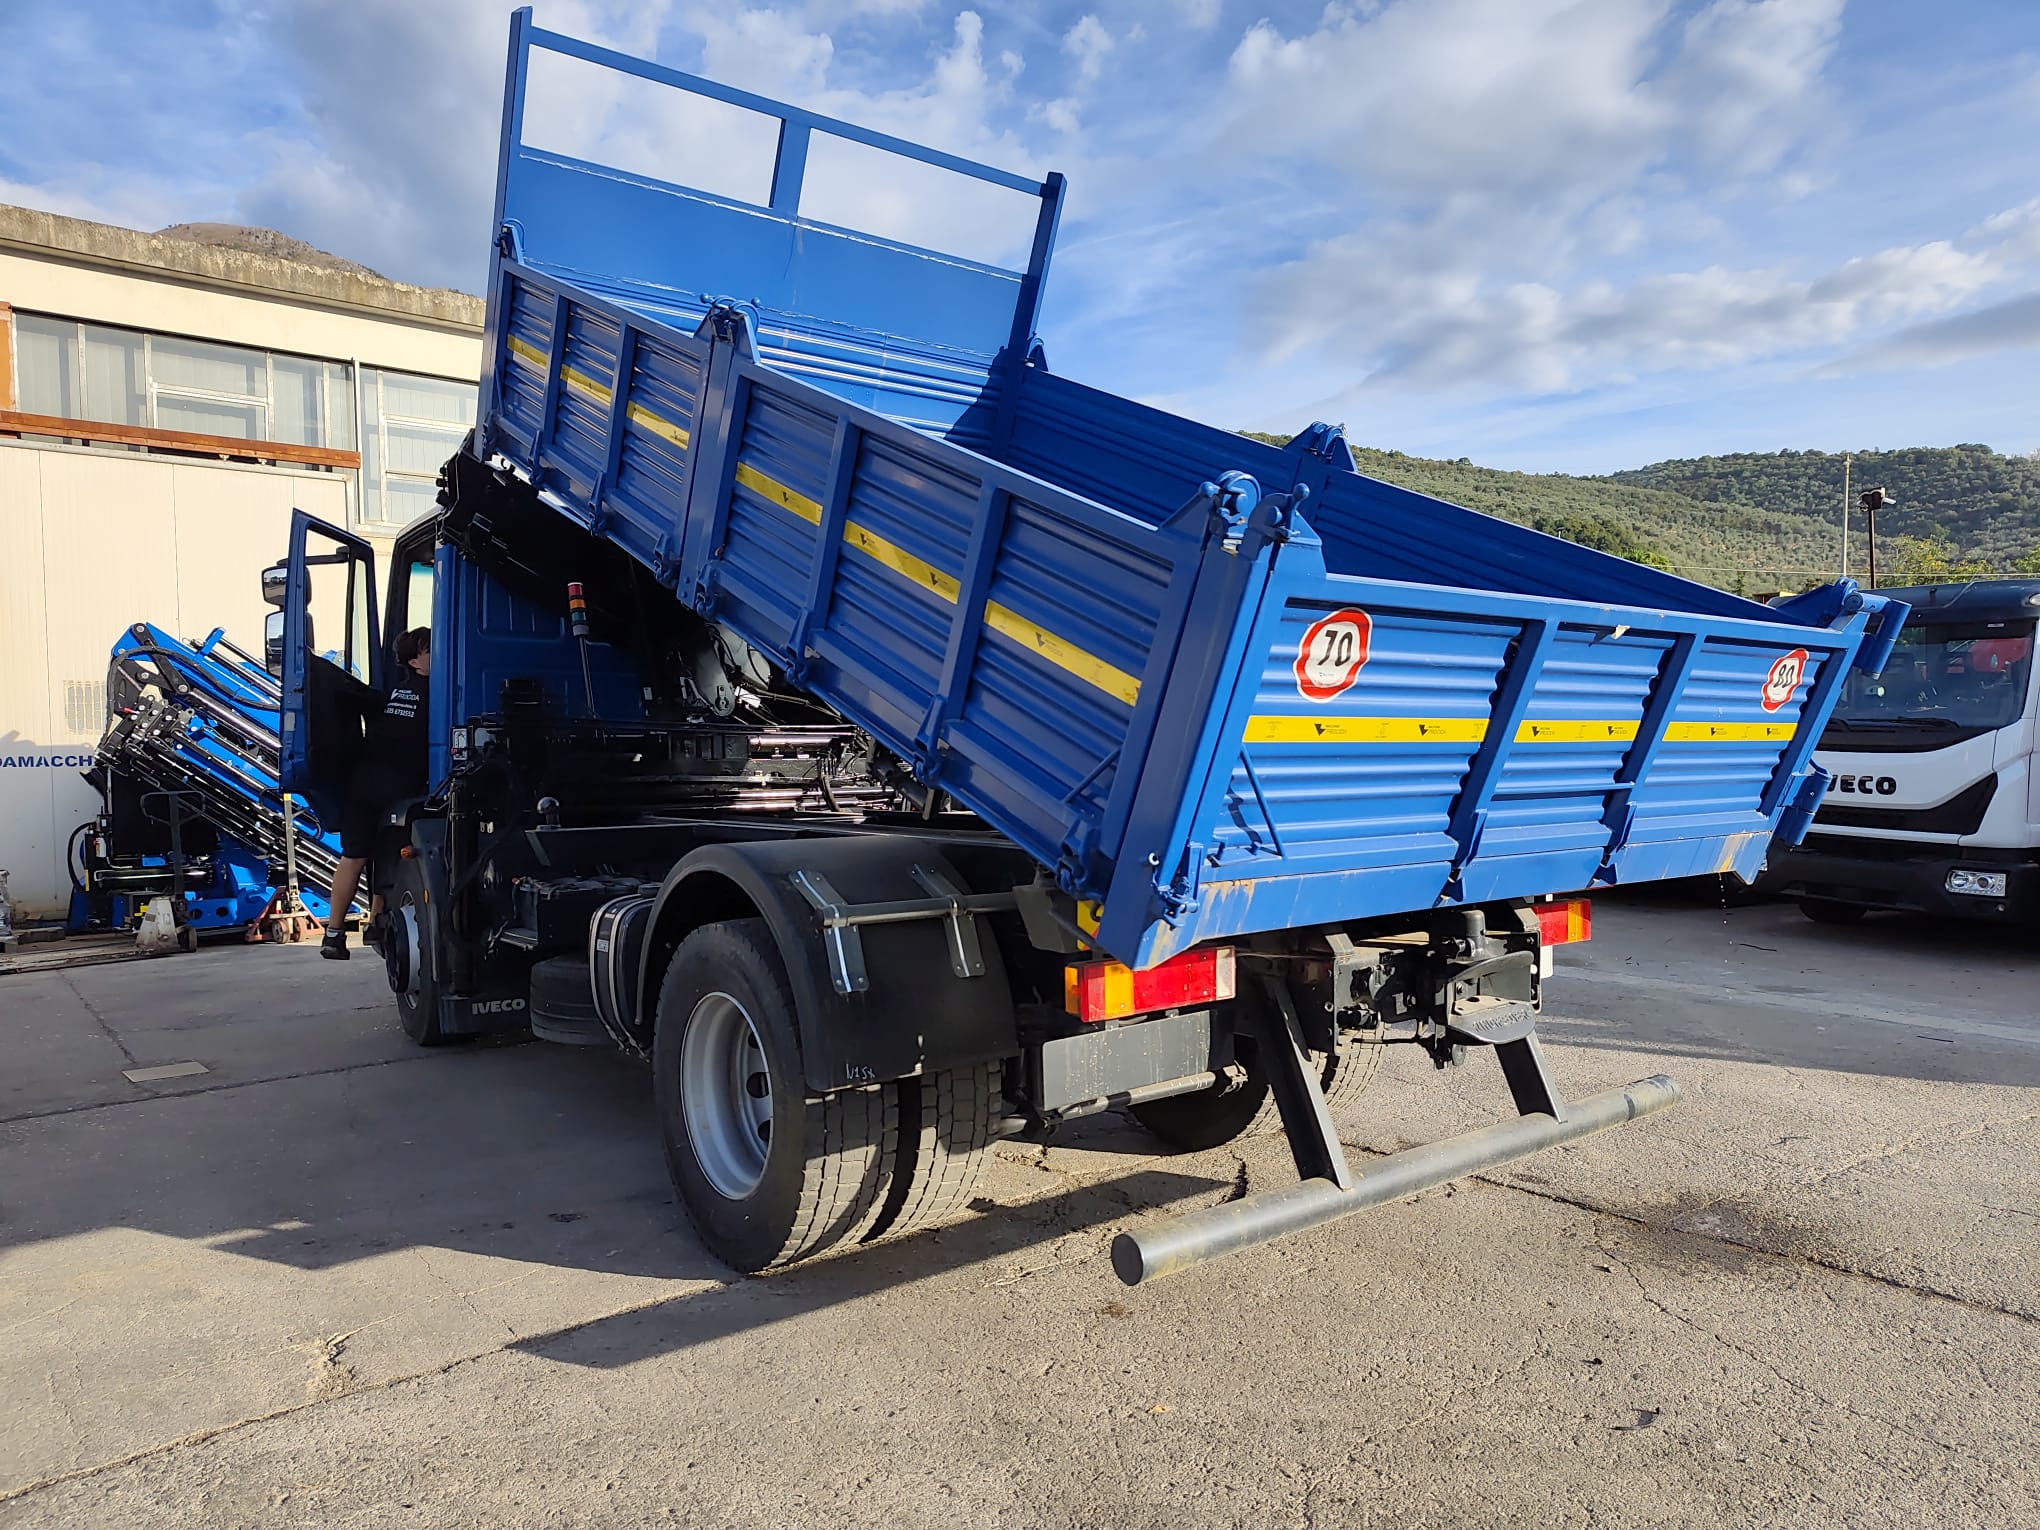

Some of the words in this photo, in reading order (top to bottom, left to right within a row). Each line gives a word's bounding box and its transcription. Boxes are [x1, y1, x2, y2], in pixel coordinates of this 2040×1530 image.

[1317, 630, 1353, 667] 70
[1773, 664, 1795, 688] 80
[0, 755, 93, 767] AMACCH
[471, 998, 526, 1015] IVECO
